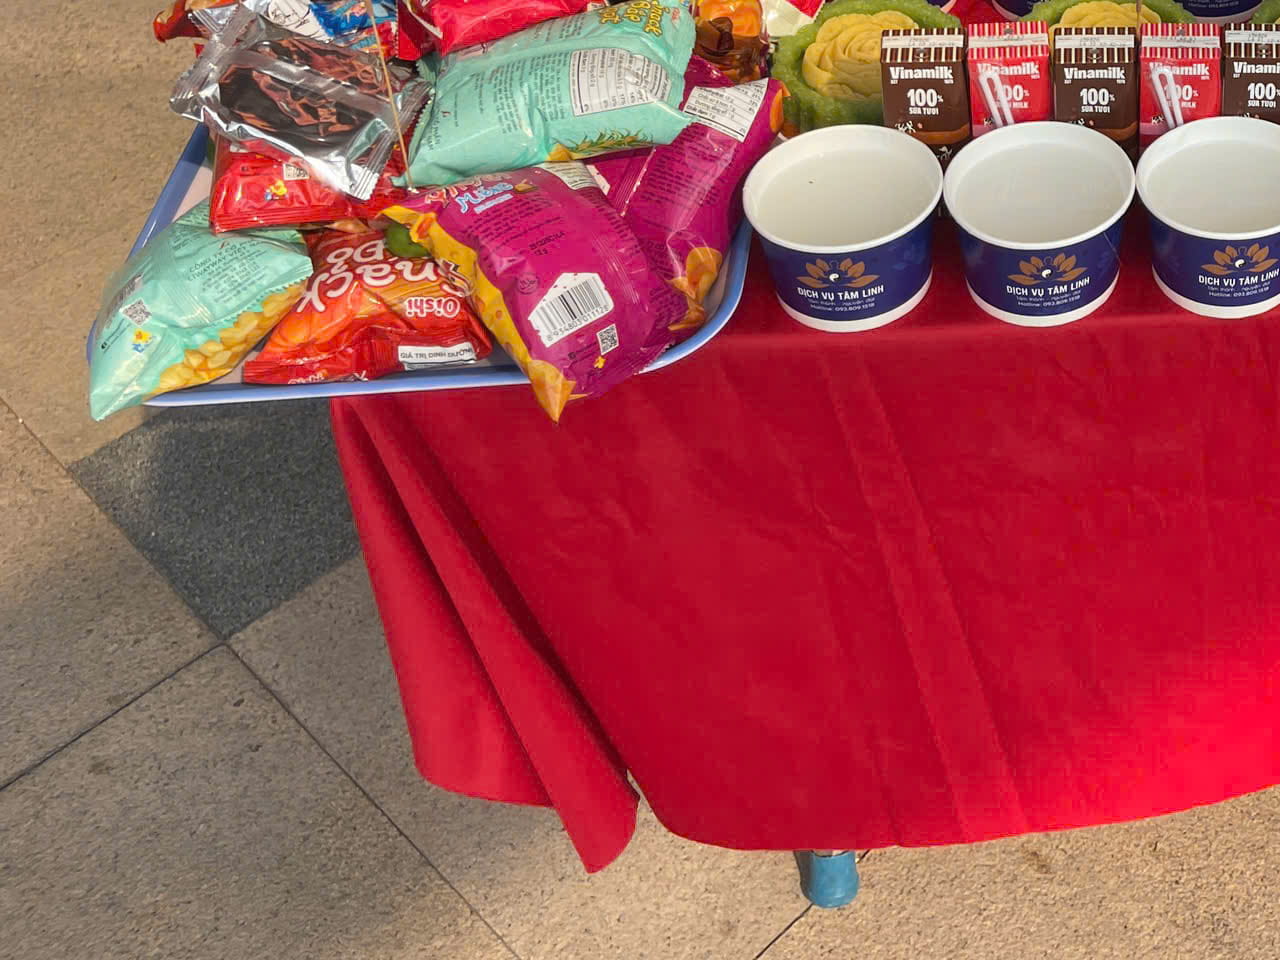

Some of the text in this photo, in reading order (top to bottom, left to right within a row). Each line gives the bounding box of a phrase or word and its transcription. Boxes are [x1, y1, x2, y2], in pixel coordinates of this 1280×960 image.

[890, 66, 954, 80] Vinamilk
[1064, 66, 1126, 80] Vinamilk
[907, 88, 944, 107] 100%
[1080, 88, 1116, 106] 100%
[1006, 276, 1090, 297] DỊCH VỤ TÂM LINH
[1198, 268, 1280, 288] DỊCH VỤ TÂM LINH
[797, 284, 884, 302] DỊCH VỤ TÂM LINH
[406, 296, 460, 319] Oishi
